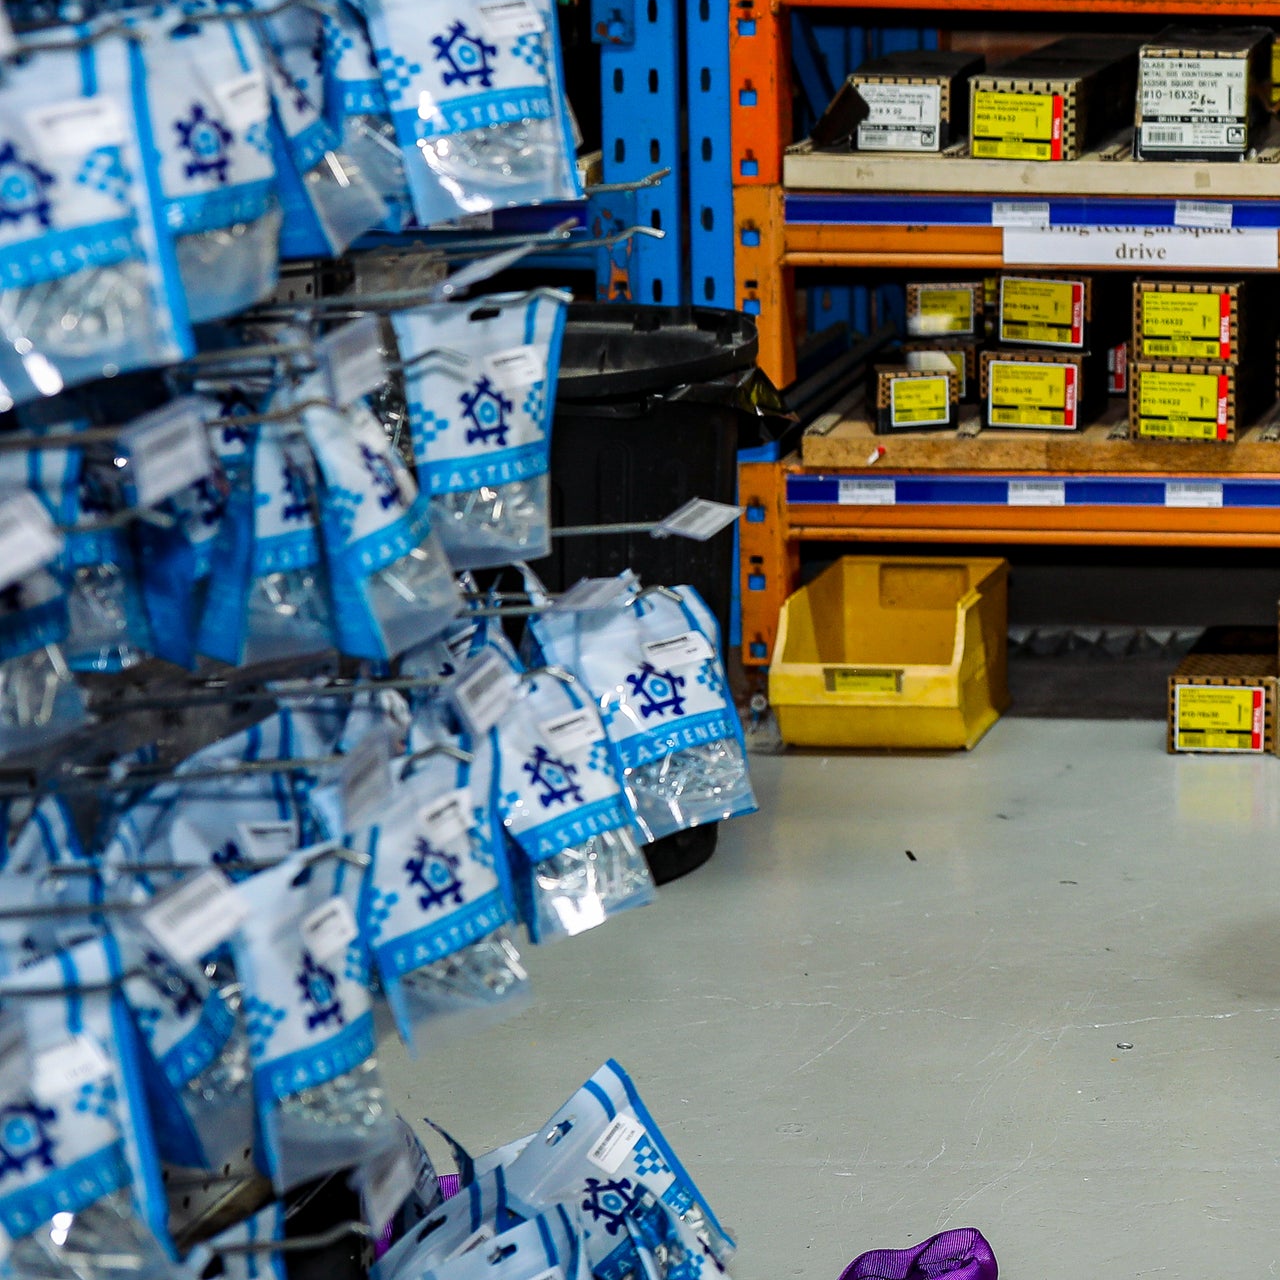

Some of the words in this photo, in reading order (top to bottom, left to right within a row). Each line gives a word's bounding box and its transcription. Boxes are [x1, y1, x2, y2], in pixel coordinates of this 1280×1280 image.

[1115, 243, 1167, 260] drive
[1073, 299, 1082, 329] METAL
[1220, 315, 1230, 343] METAL
[1066, 381, 1075, 411] METAL
[1218, 396, 1227, 425] METAL
